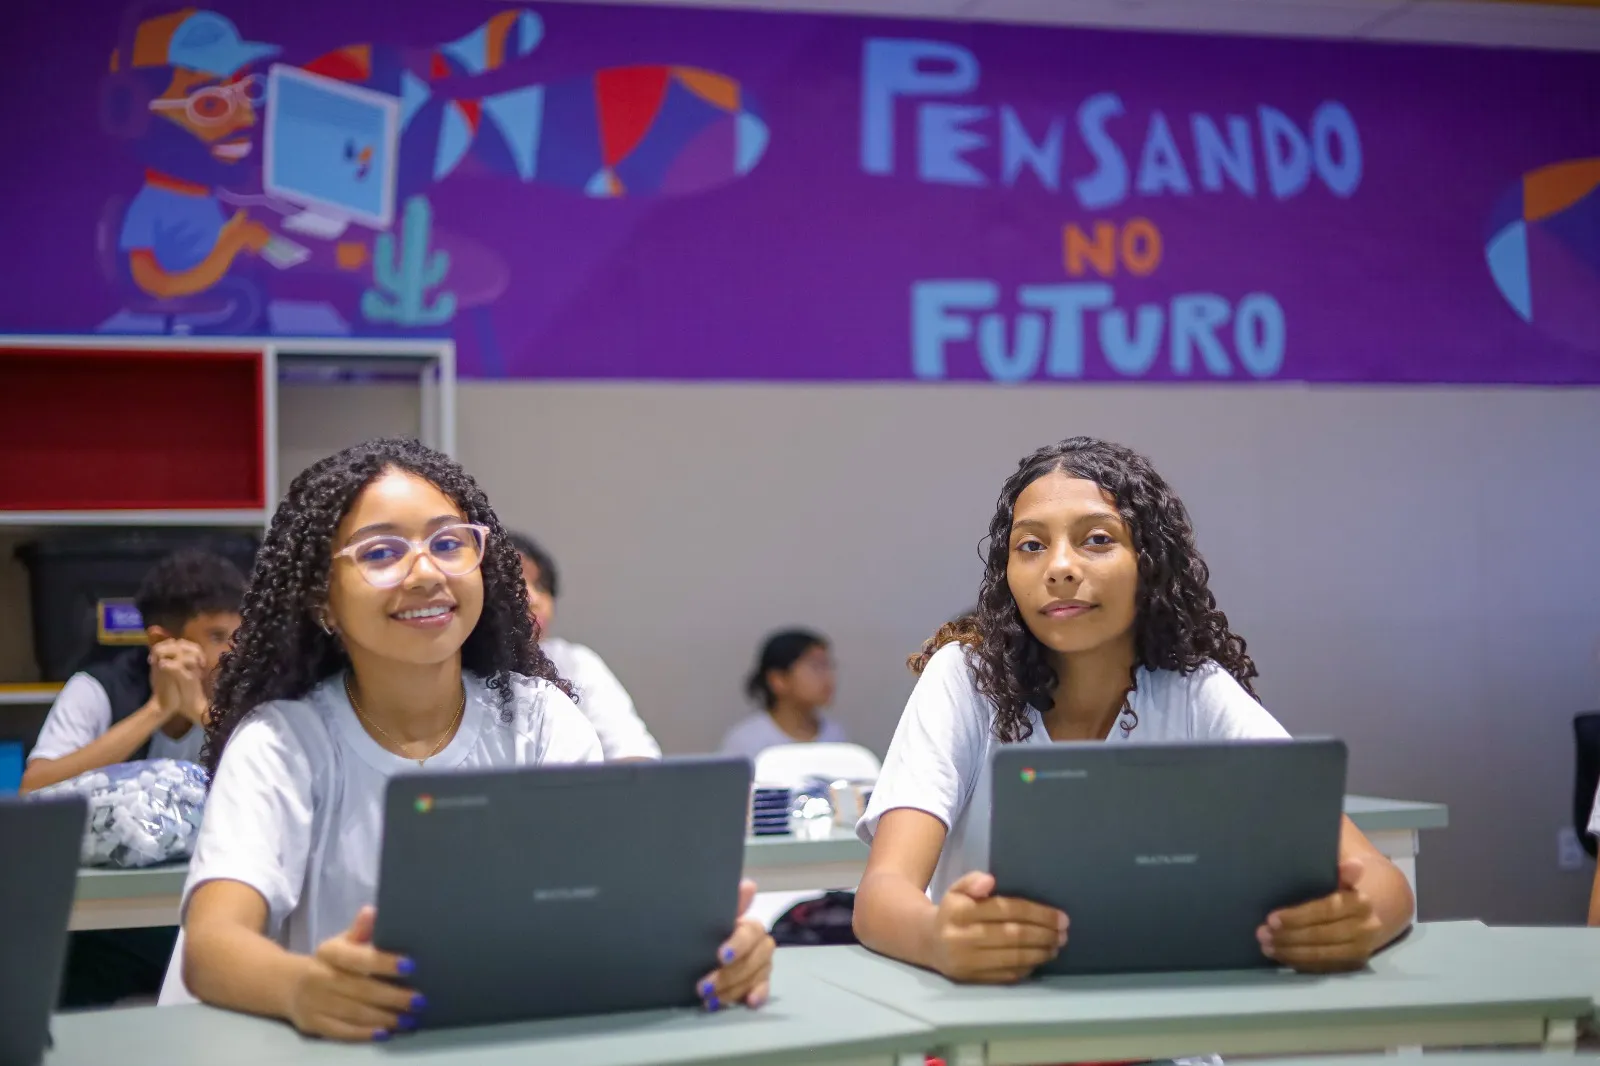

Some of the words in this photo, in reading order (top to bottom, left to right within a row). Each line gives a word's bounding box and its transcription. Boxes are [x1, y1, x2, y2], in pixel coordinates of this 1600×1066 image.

[861, 38, 1363, 209] PENSANDO
[1063, 217, 1163, 275] NO
[910, 281, 1286, 382] FUTURO
